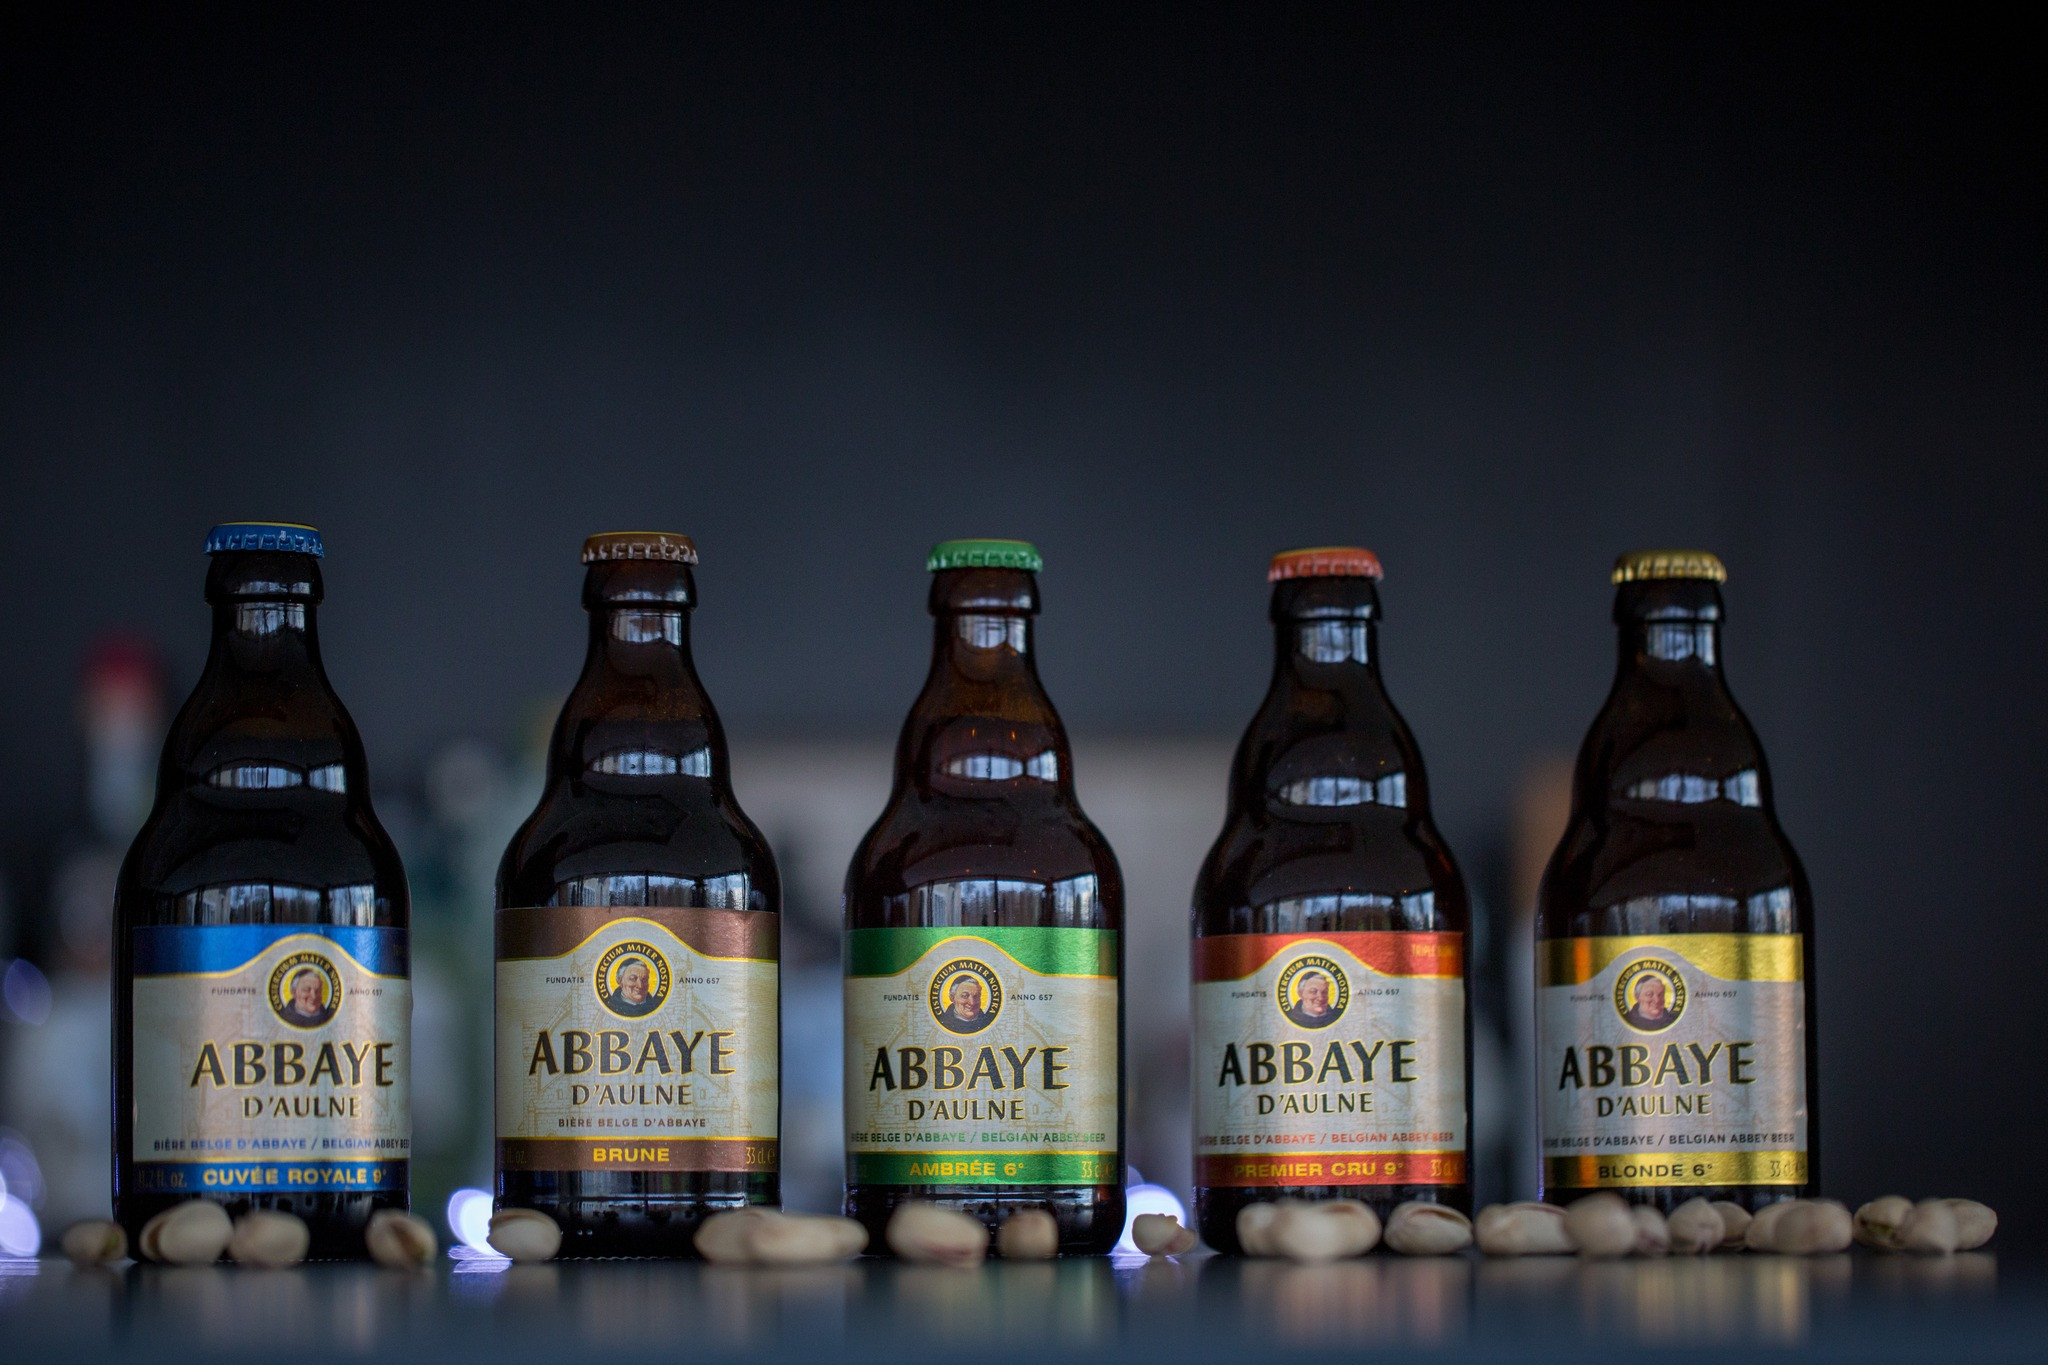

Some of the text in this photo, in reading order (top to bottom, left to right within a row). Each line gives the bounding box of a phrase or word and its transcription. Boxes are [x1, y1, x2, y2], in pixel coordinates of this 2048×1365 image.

[546, 976, 584, 984] FUNDATIS
[598, 944, 668, 999] CISTERCIUM MATER NOSTRA
[678, 976, 720, 985] ANNO 657
[932, 962, 1000, 1016] CISTERCIUM MATER NOSTRA
[1280, 958, 1347, 1012] CISTERCIUM MATER NOSTRA
[884, 994, 920, 1002] FUNDATIS
[1010, 993, 1053, 1002] ANNO 657
[528, 1030, 737, 1078] ABBAYE
[190, 1040, 395, 1090] ABBAYE
[869, 1045, 1071, 1092] ABBAYE
[1218, 1040, 1420, 1088] ABBAYE
[1558, 1040, 1758, 1092] ABBAYE
[572, 1084, 693, 1107] D'AULNE
[1257, 1092, 1375, 1116] D'AULNE
[242, 1094, 362, 1119] D'AULNE
[908, 1099, 1026, 1122] D'AULNE
[1597, 1094, 1714, 1118] D'AULNE
[558, 1117, 706, 1128] BIÈRE BELGE D'ABBAYE
[190, 1138, 232, 1150] BELGE
[236, 1138, 306, 1150] D'ABBAYE
[322, 1138, 372, 1150] BELGIAN
[374, 1138, 400, 1150] ABBEY
[871, 1132, 900, 1142] BELGE
[904, 1132, 966, 1142] D'ABBAYE
[970, 1132, 977, 1144] /
[982, 1132, 1039, 1142] BELGIAN
[1043, 1132, 1080, 1142] ABBEY
[1084, 1132, 1106, 1142] BEER
[1220, 1135, 1250, 1145] BELGE
[1254, 1134, 1316, 1144] D'ABBAYE
[1320, 1132, 1327, 1144] /
[1331, 1132, 1388, 1143] BELGIAN
[1392, 1132, 1429, 1142] ABBEY
[1432, 1132, 1454, 1142] BEER
[1594, 1135, 1654, 1146] D'ABBAYE
[1658, 1134, 1664, 1146] /
[1669, 1134, 1726, 1144] BELGIAN
[1730, 1134, 1769, 1144] ABBEY
[1772, 1134, 1794, 1143] BEER
[593, 1148, 670, 1162] BRUNE
[746, 1146, 756, 1164] 33
[203, 1165, 278, 1186] CUVÉE
[287, 1168, 368, 1184] ROYALE
[910, 1160, 1024, 1176] AMBRÉE 6°
[1082, 1160, 1092, 1178] 33
[1234, 1162, 1323, 1178] PREMIER
[1331, 1162, 1376, 1176] CRU
[1384, 1162, 1404, 1176] 9°
[1598, 1163, 1713, 1179] BLONDE 6°
[1770, 1160, 1780, 1178] 33
